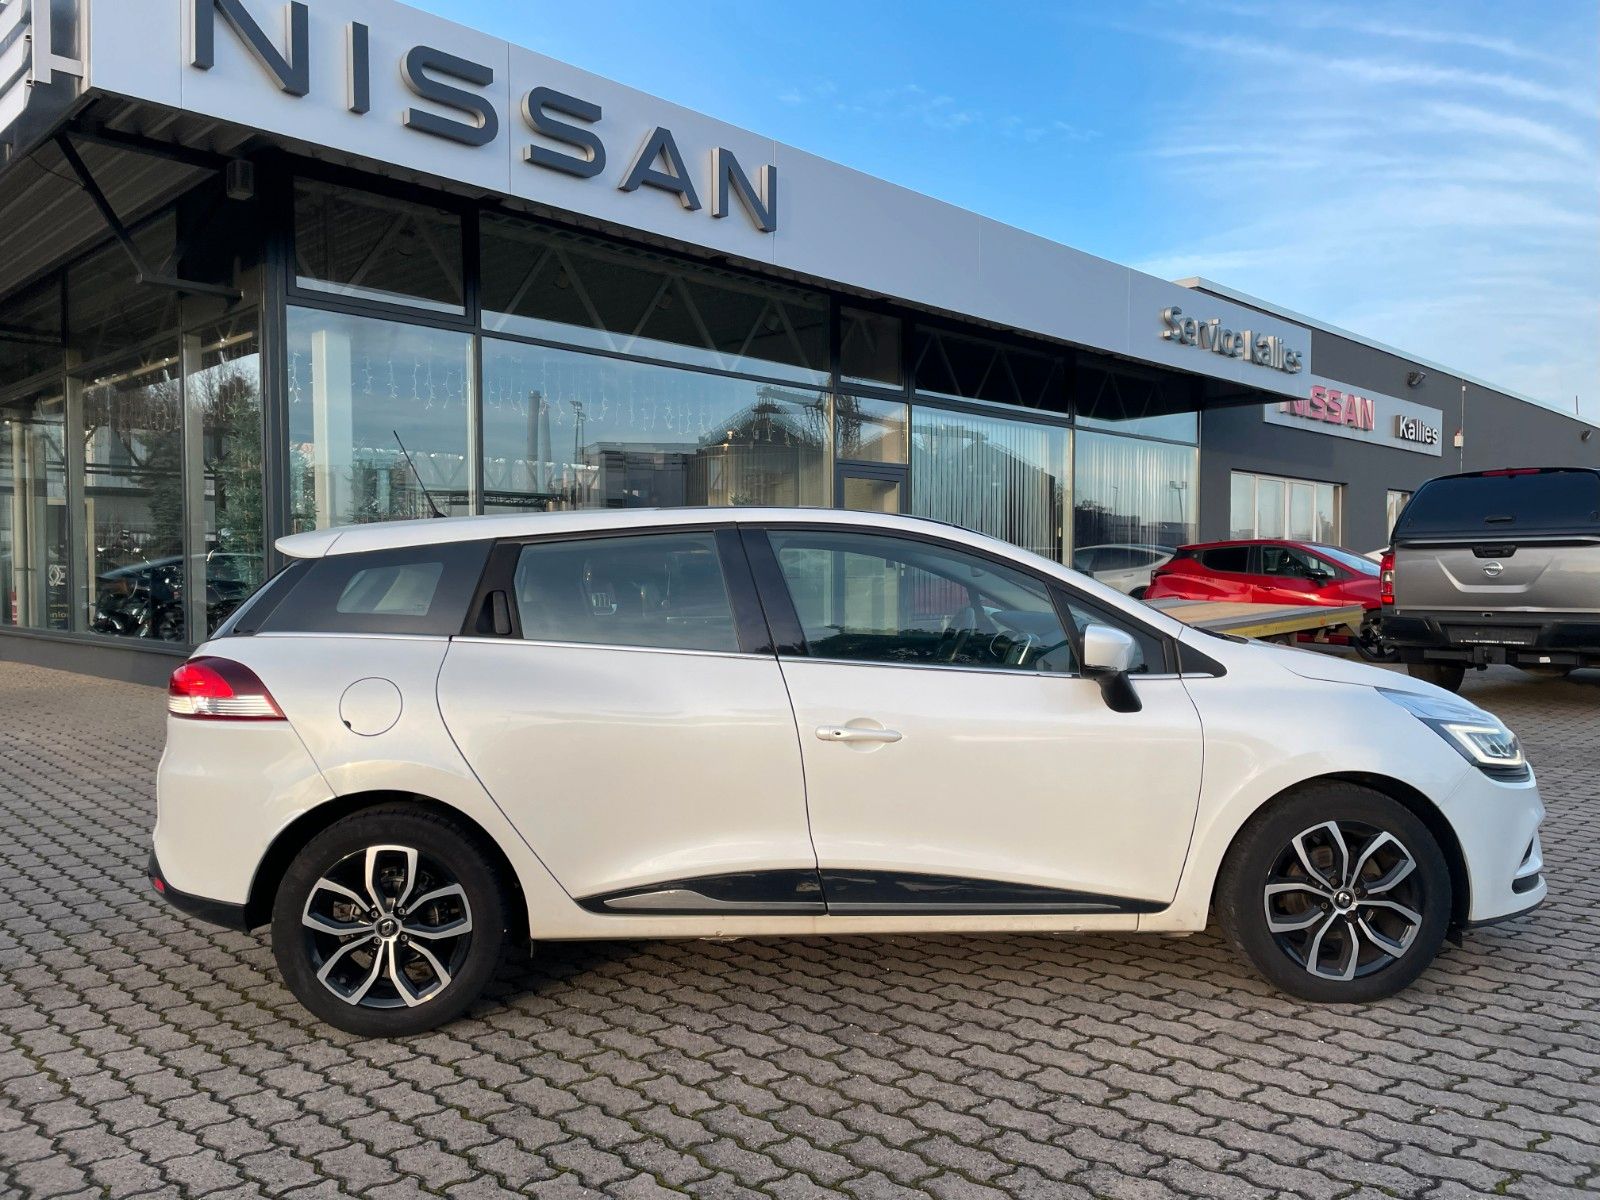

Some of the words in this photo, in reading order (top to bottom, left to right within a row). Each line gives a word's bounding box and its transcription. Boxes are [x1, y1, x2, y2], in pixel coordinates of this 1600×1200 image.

[191, 0, 777, 232] NISSAN
[1162, 306, 1244, 358] Service
[1244, 330, 1303, 374] Kallies
[1396, 414, 1439, 445] Kallies
